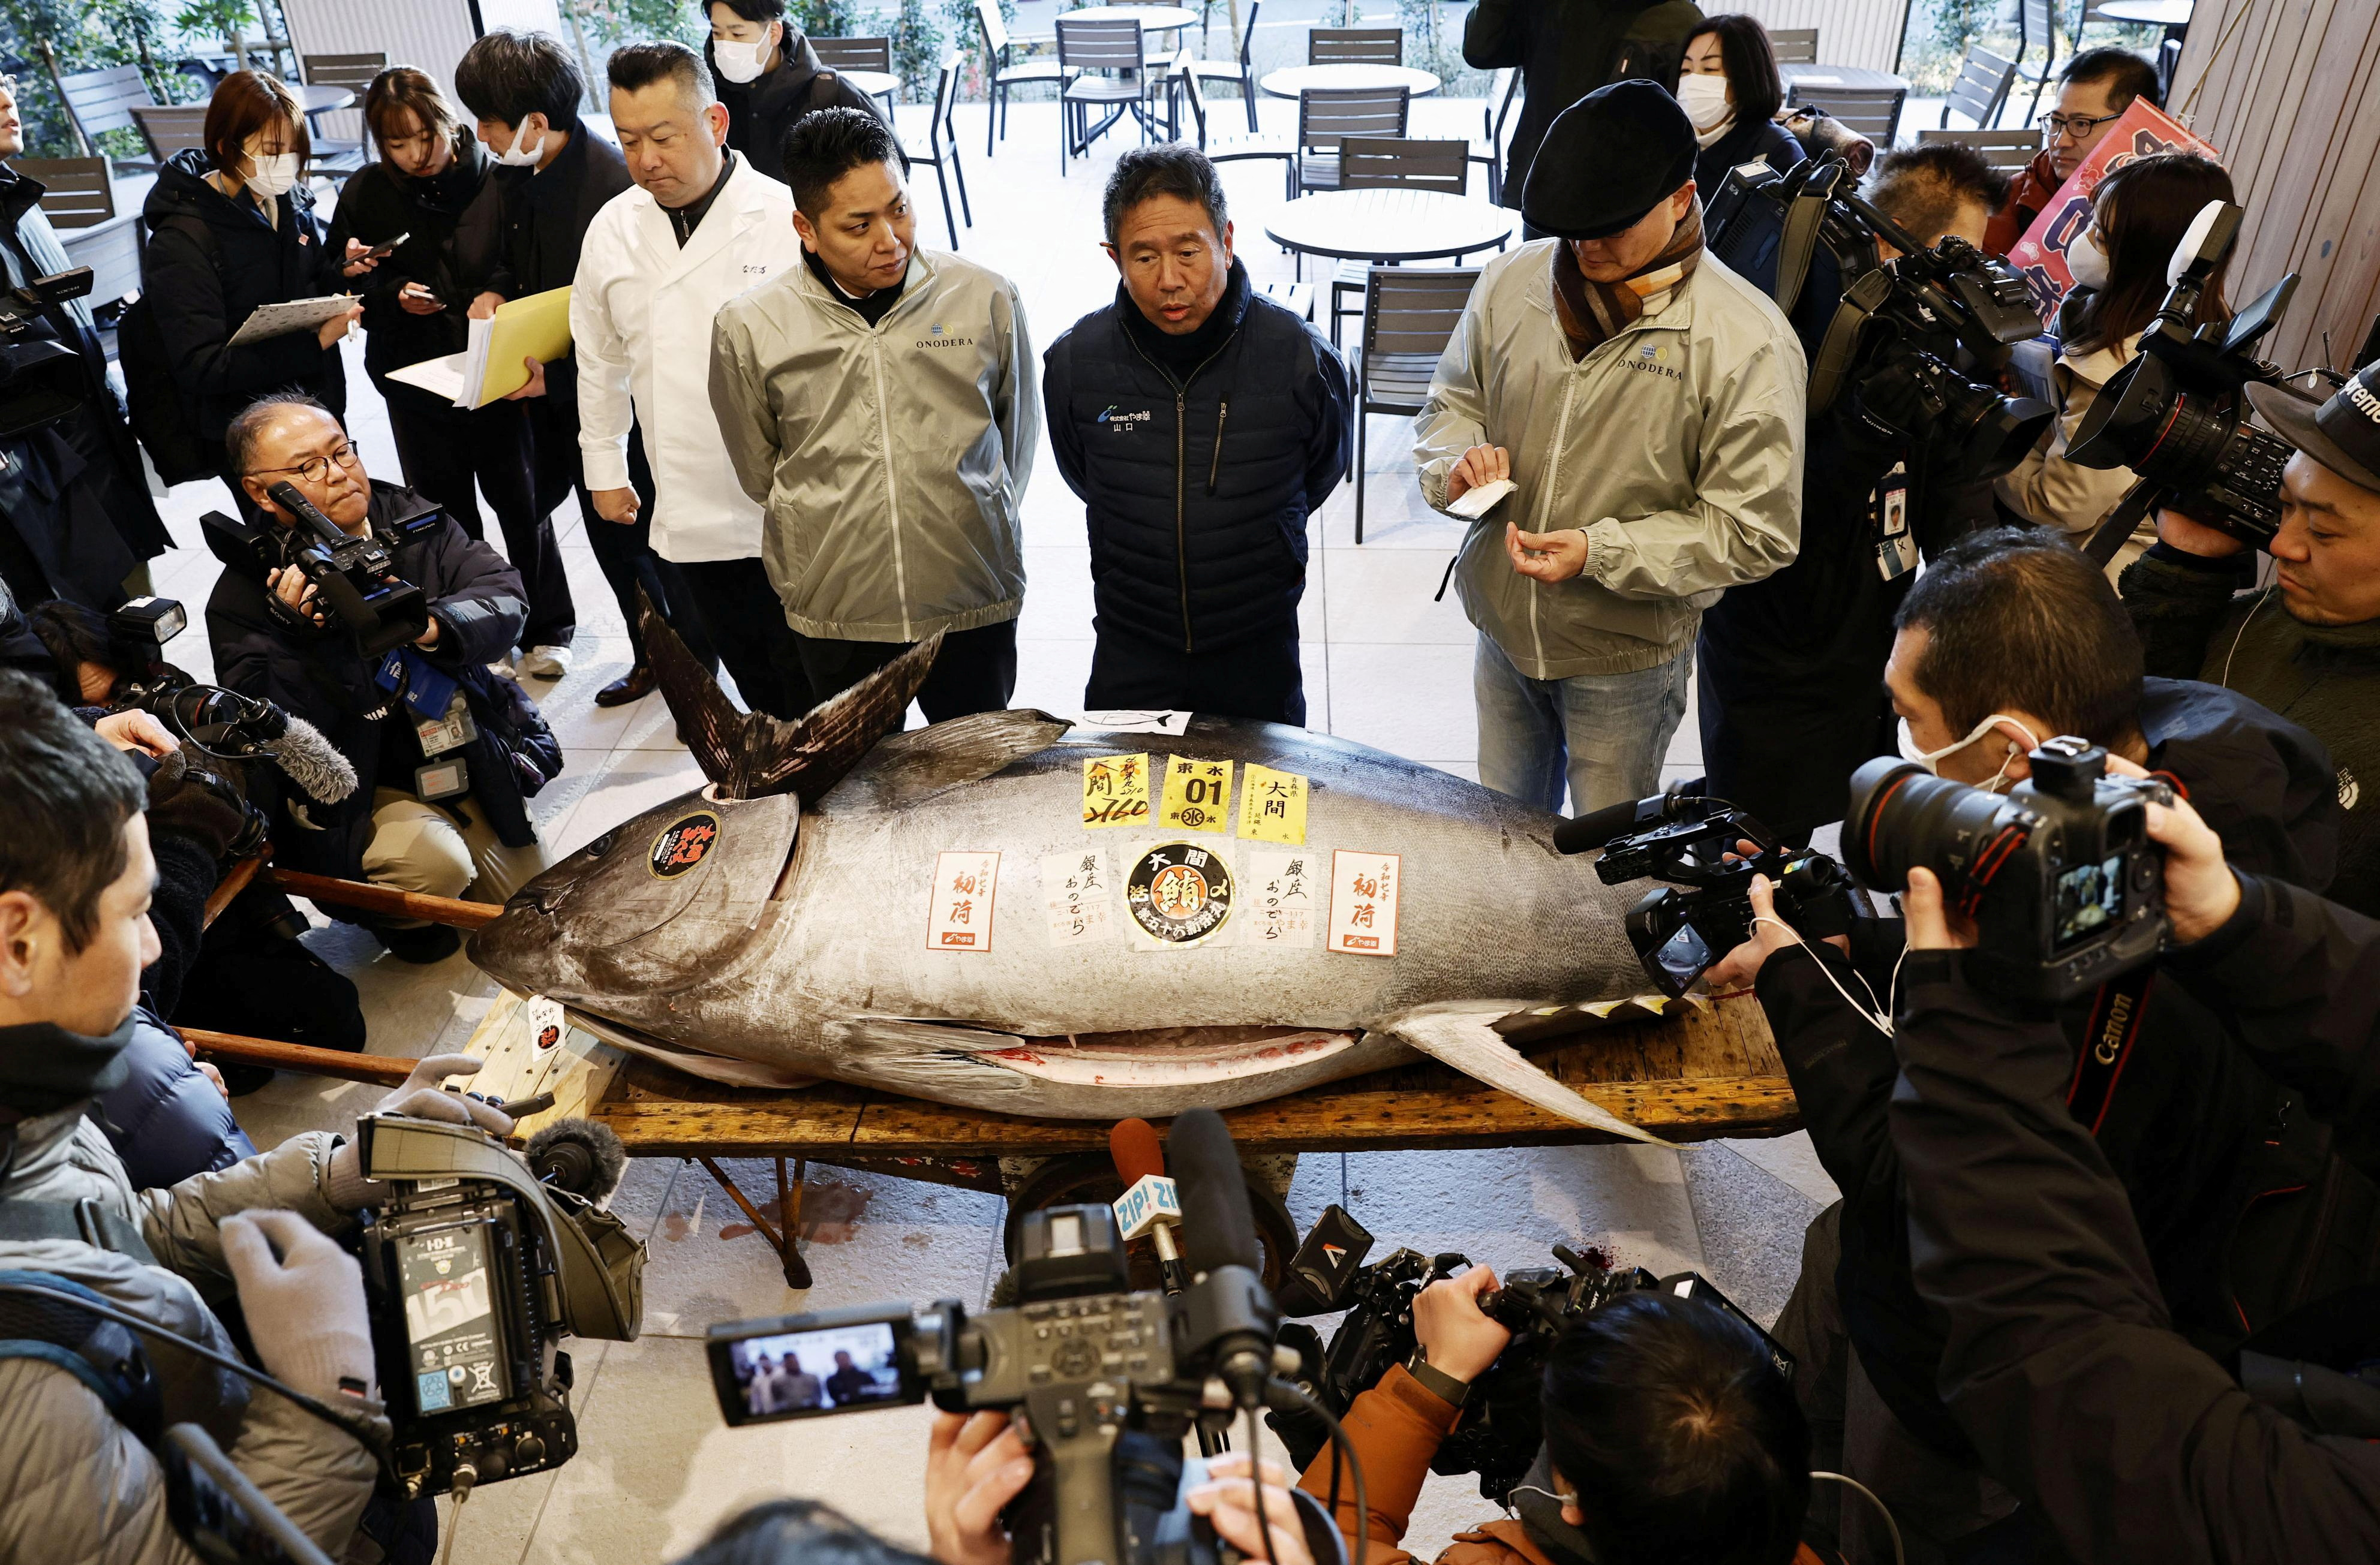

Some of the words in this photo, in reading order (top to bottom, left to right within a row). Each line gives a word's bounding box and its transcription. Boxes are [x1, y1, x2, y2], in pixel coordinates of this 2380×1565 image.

[916, 338, 973, 348] ONODERA
[1618, 359, 1682, 380] ONODERA
[1113, 423, 1133, 432] 山口
[1862, 414, 1893, 435] FUJINON
[270, 607, 292, 625] SONY
[1185, 778, 1222, 805] 01
[1290, 777, 1299, 797] 青森県
[2340, 768, 2353, 785] THE
[1265, 781, 1289, 819] 大間
[1080, 855, 1102, 891] 銀座
[1148, 848, 1209, 871] 大間
[977, 859, 990, 898] 令和七年
[1154, 869, 1200, 913] 鮪
[1282, 859, 1308, 899] 銀座
[1380, 862, 1391, 902] 令和七年
[949, 871, 976, 925] 初荷
[1065, 875, 1084, 936] おのでら
[1266, 879, 1282, 940] おのでら
[1351, 873, 1377, 929] 初荷
[955, 935, 974, 943] やま幸
[1358, 939, 1378, 947] やま幸
[2095, 993, 2133, 1065] Canon
[1117, 1184, 1152, 1232] ZIP!
[405, 1268, 491, 1340] 150
